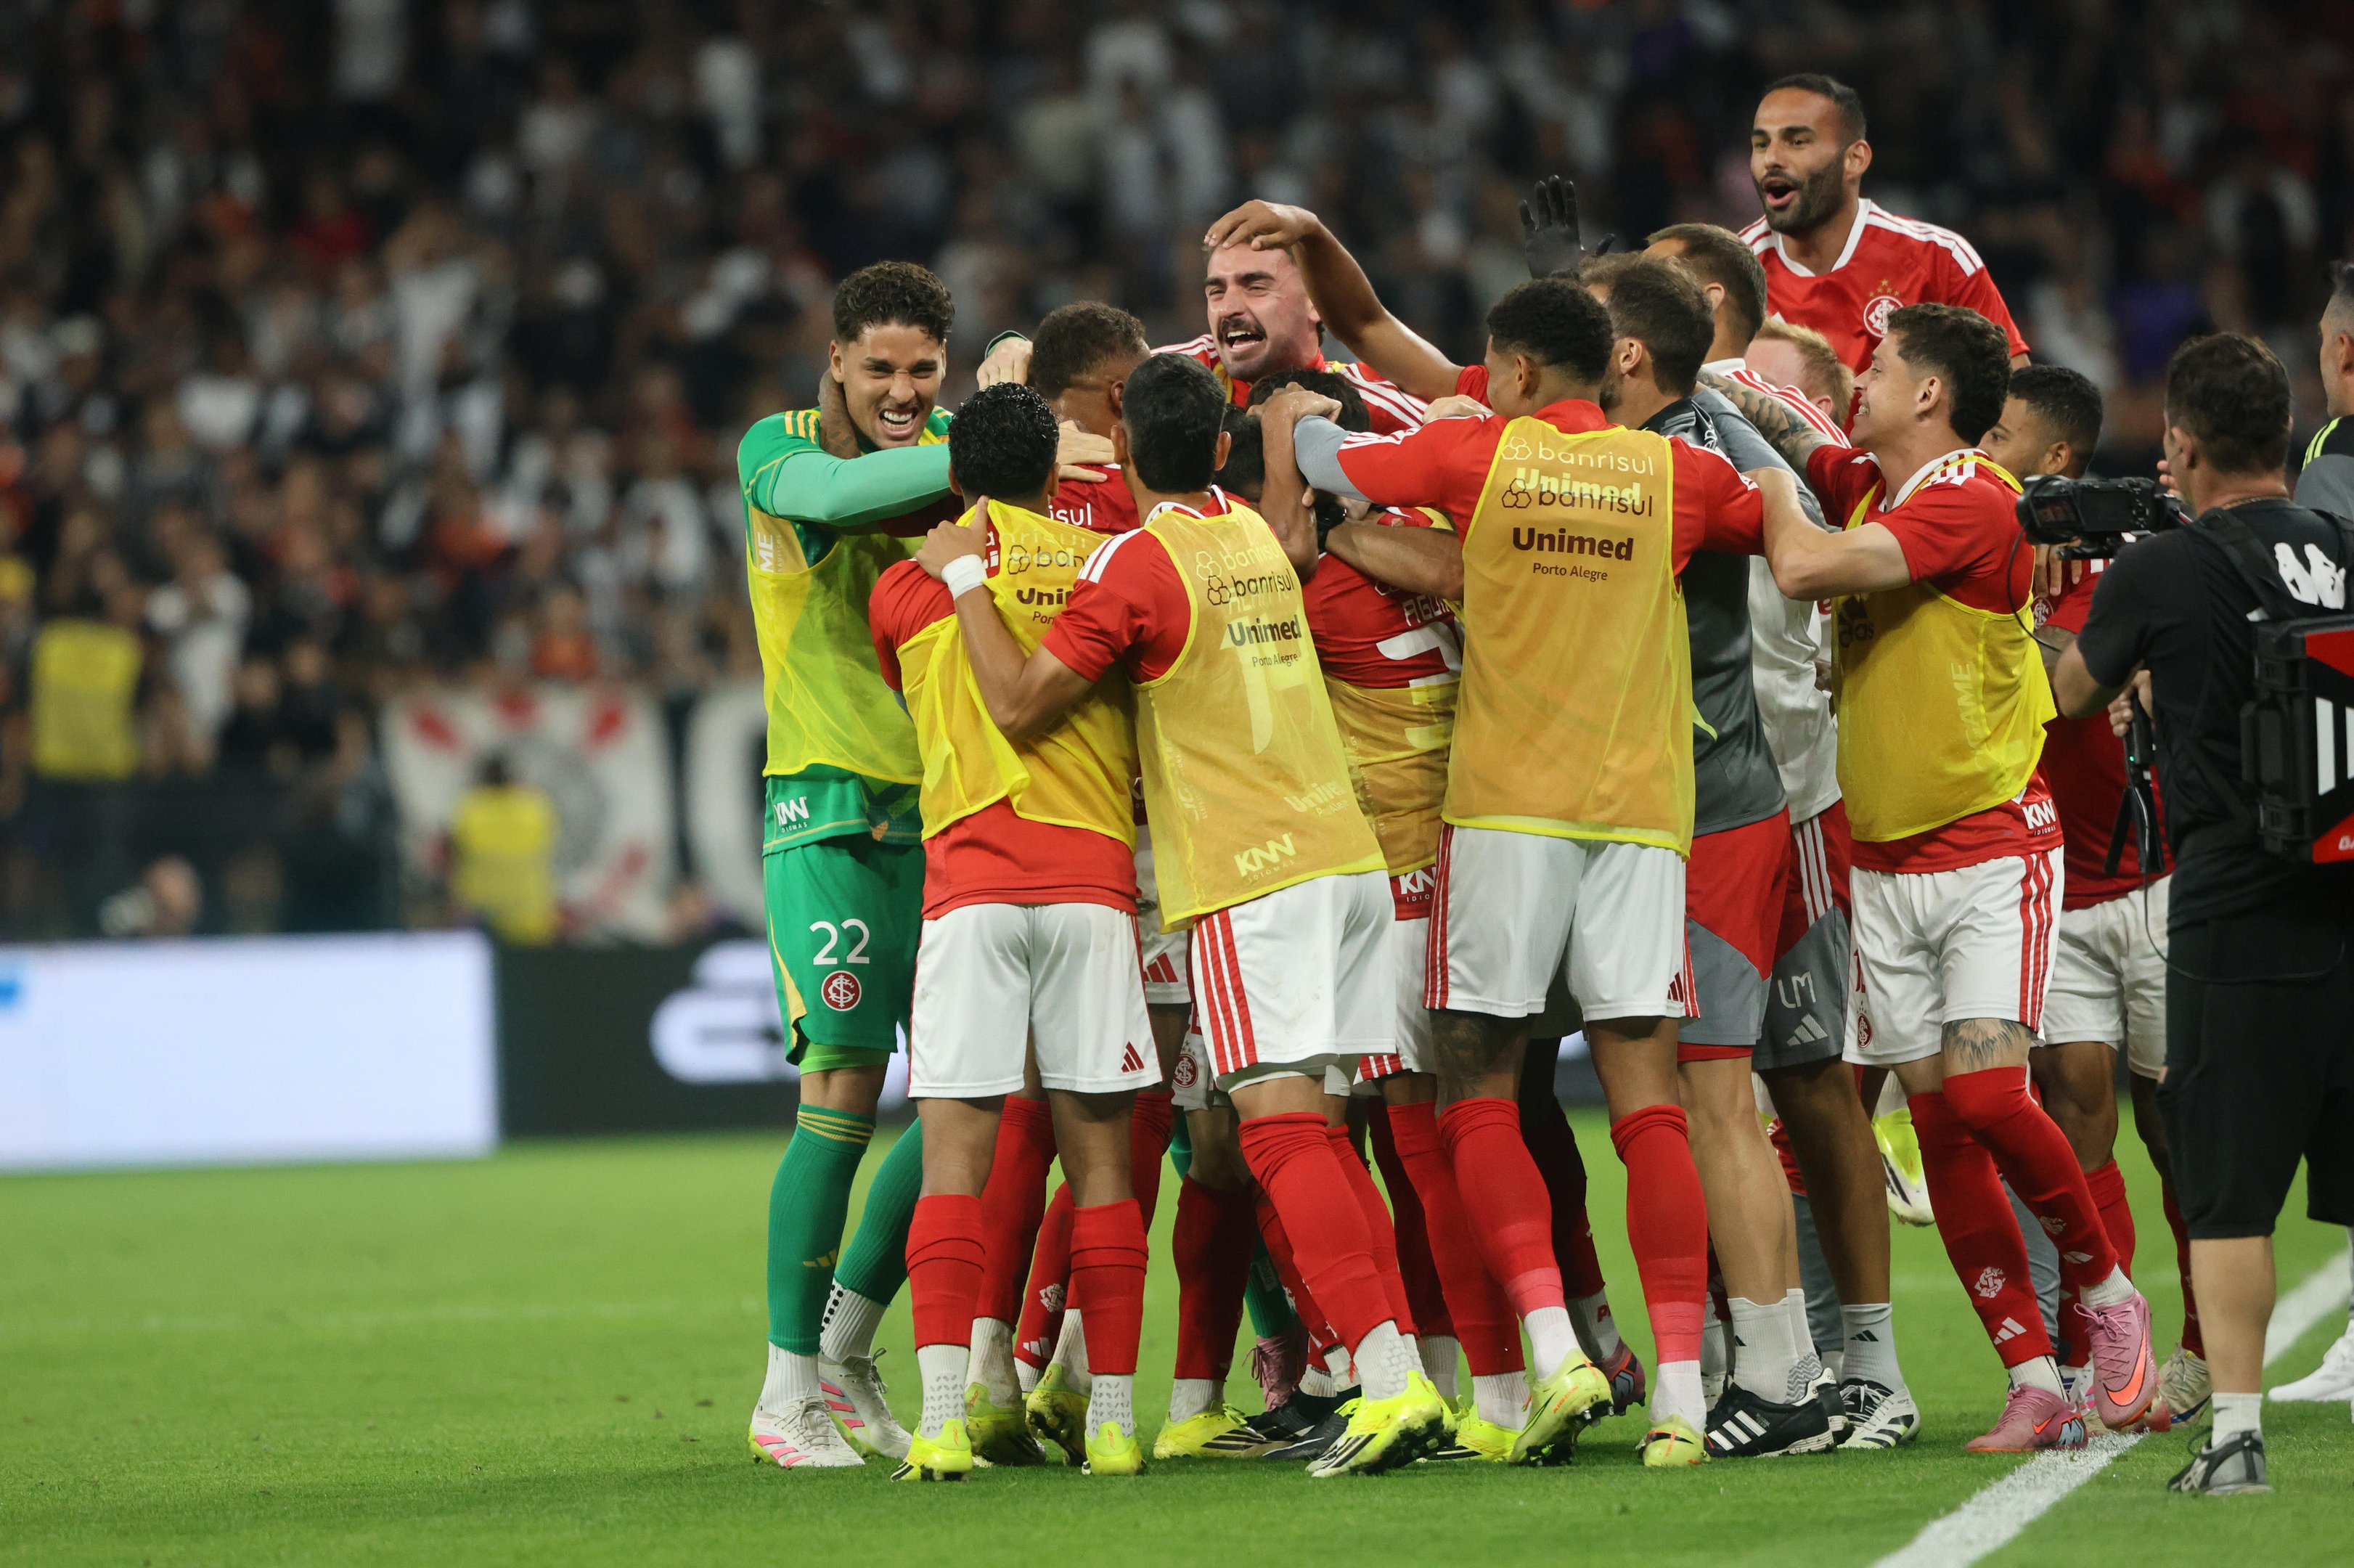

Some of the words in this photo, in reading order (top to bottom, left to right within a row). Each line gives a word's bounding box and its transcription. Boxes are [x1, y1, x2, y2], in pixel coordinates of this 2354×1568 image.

[1538, 441, 1654, 476] banrisul
[1516, 467, 1641, 506] Unimed
[1538, 483, 1653, 517] banrisul
[1037, 546, 1089, 568] ban
[1512, 527, 1634, 561] Unimed
[1231, 568, 1295, 597] banrisul
[1532, 563, 1567, 576] Porto
[1569, 565, 1608, 582] Alegre
[1227, 614, 1302, 647] Unimed
[1251, 656, 1272, 667] Porto
[1273, 653, 1299, 667] Alegre
[2022, 798, 2056, 830] KNN
[1234, 833, 1296, 877] KNN
[809, 918, 870, 965] 22
